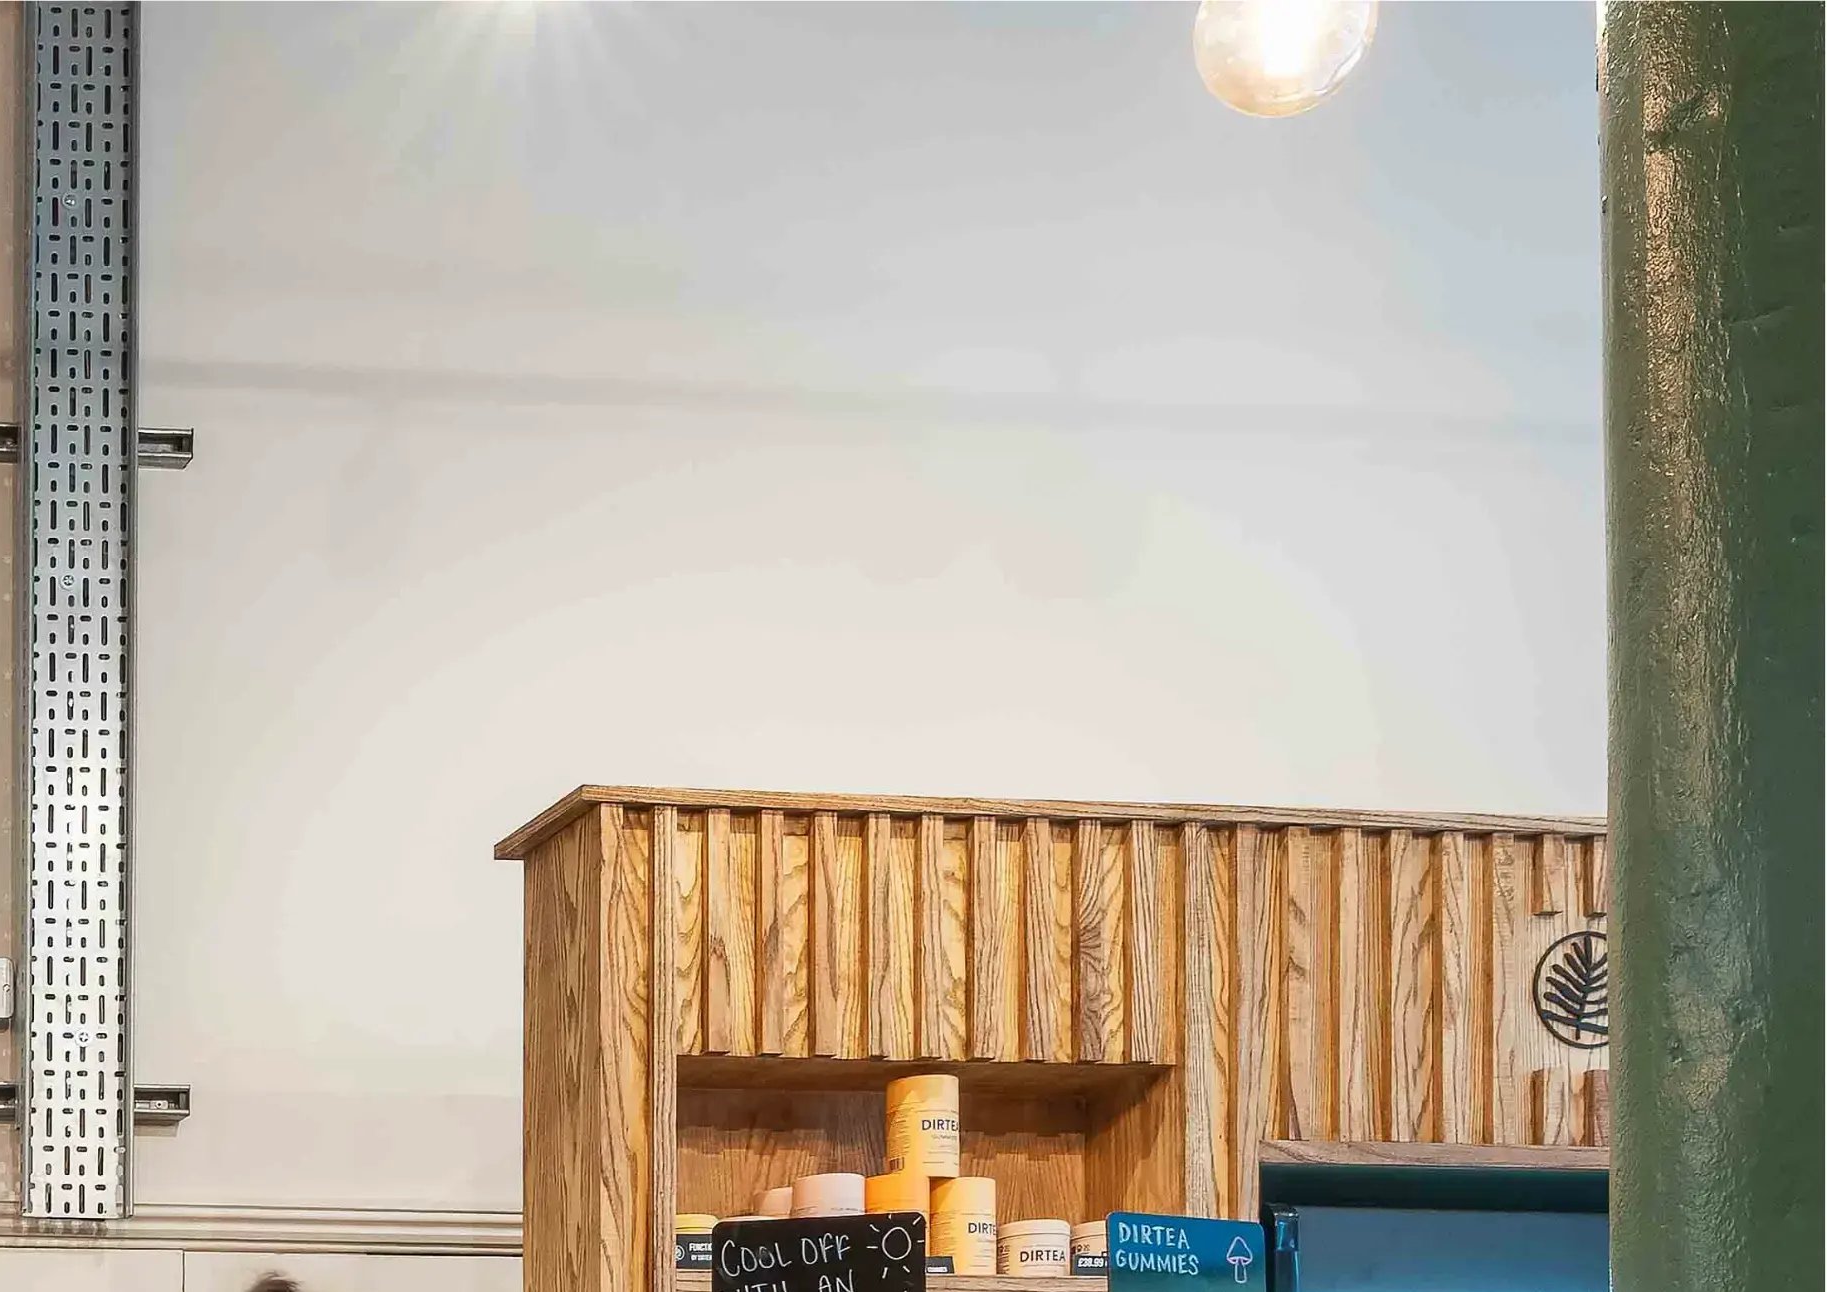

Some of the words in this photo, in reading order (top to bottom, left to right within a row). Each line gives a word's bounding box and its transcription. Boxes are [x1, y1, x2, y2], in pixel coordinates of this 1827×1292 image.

[1118, 1222, 1190, 1250] DIRTEA
[721, 1239, 792, 1277] COOL
[801, 1233, 850, 1265] OFF
[1019, 1249, 1066, 1264] DIRTEA
[1116, 1251, 1199, 1275] GUMMIES
